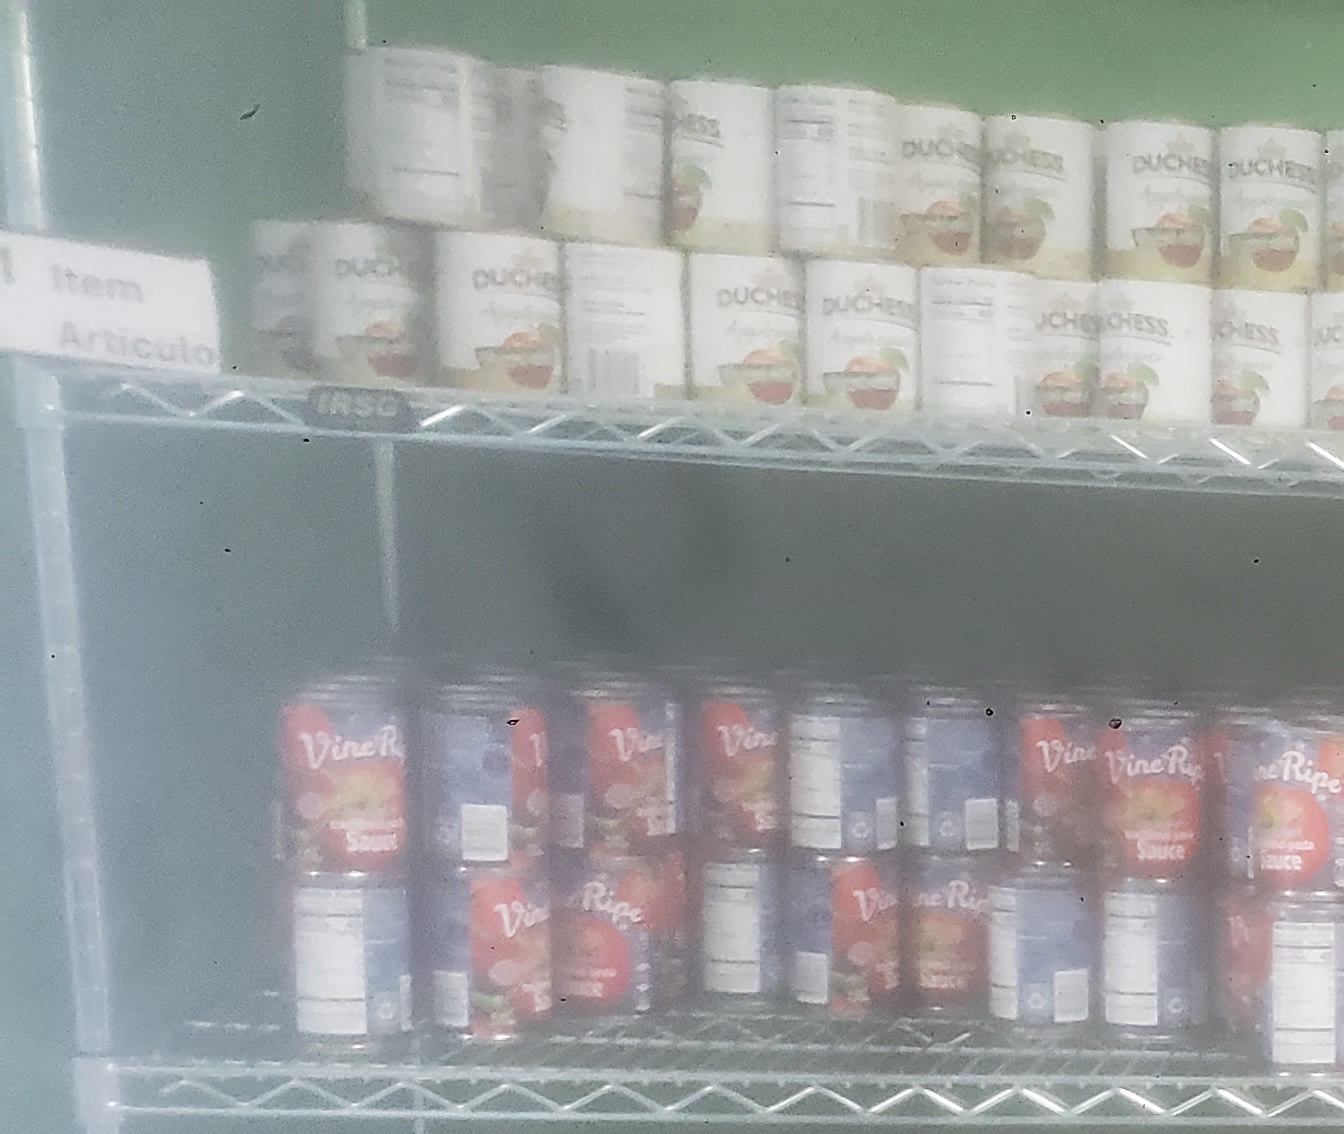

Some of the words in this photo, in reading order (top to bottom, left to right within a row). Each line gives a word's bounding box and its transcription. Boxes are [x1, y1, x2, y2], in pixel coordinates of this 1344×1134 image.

[51, 261, 144, 304] Item
[1101, 312, 1169, 337] CHESS
[1212, 319, 1280, 347] CHESS
[299, 731, 375, 770] Vine
[1105, 748, 1162, 786] Vine
[1280, 750, 1343, 796] Ripe
